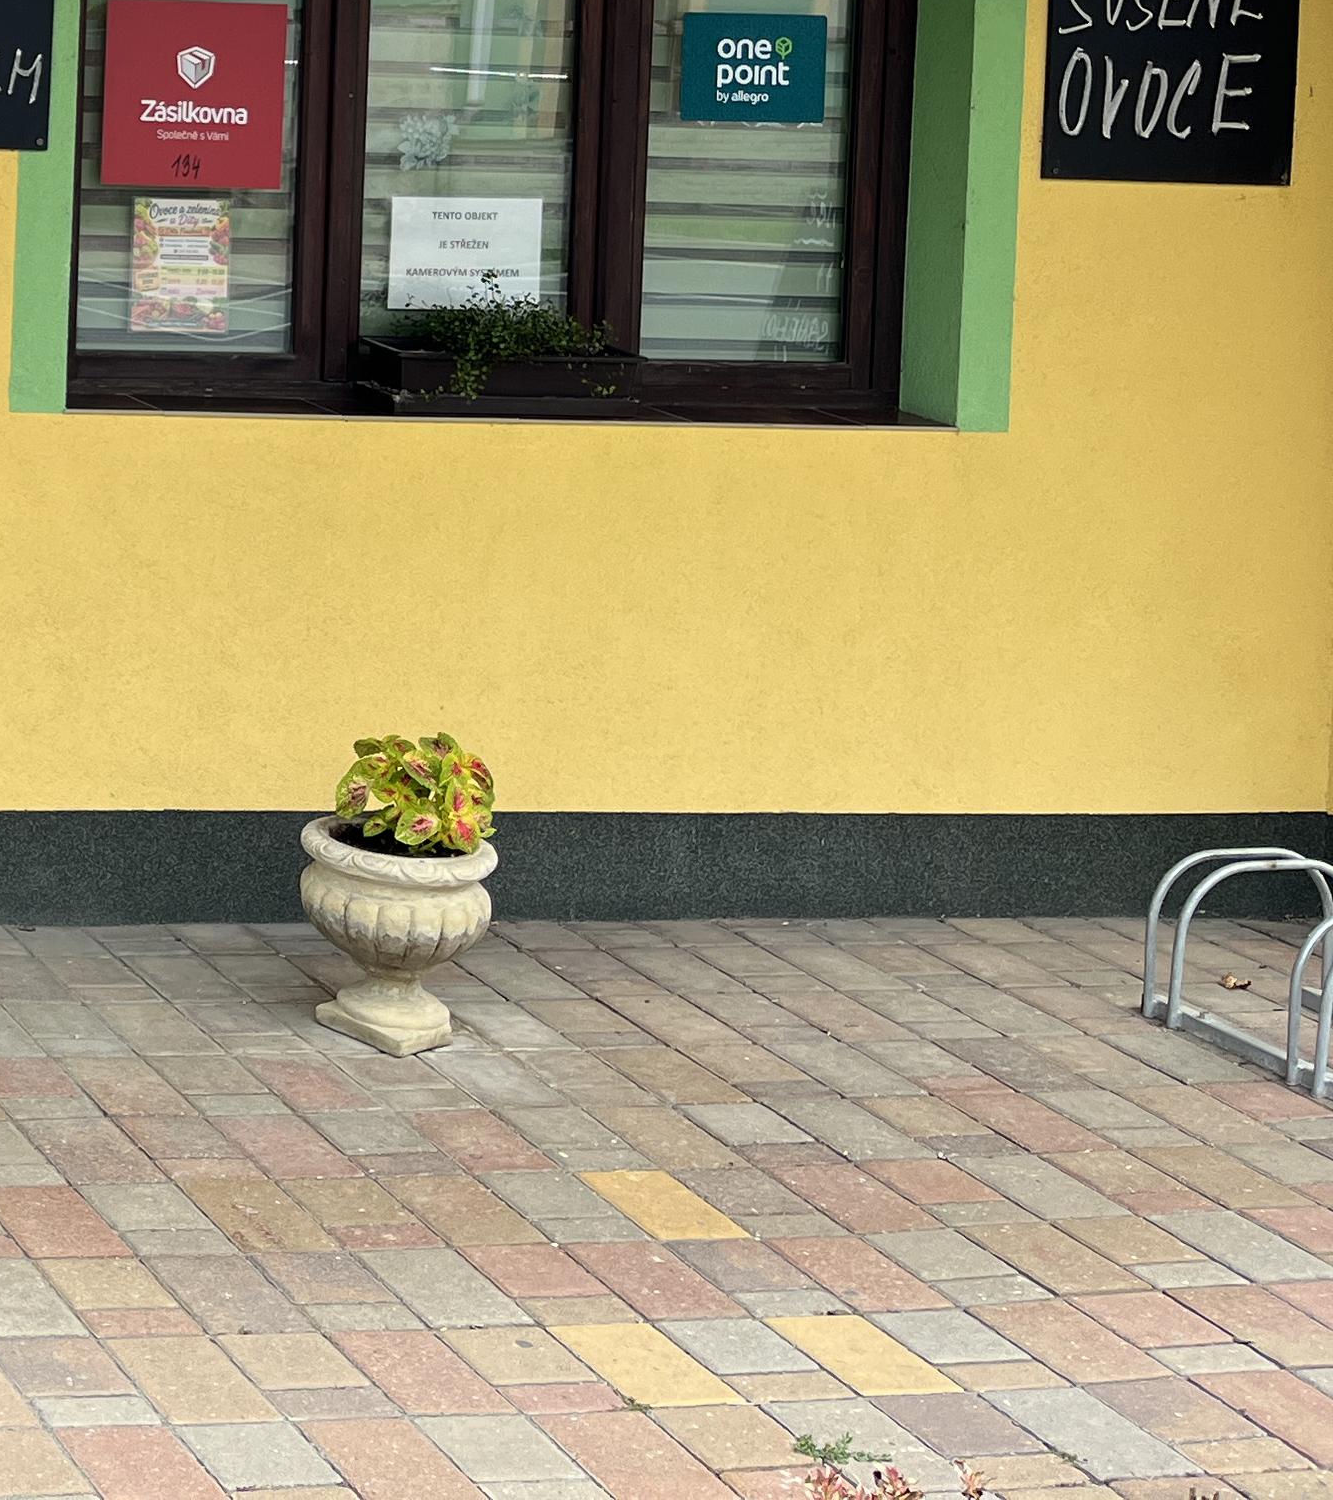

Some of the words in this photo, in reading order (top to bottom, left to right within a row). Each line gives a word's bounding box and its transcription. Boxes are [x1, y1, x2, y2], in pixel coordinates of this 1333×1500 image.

[717, 38, 772, 59] one
[717, 62, 790, 88] point
[716, 90, 729, 103] by
[731, 90, 769, 105] allegro
[1058, 47, 1262, 139] OVOCE
[140, 99, 248, 125] Zásilkovna
[156, 128, 198, 142] Společně
[206, 131, 229, 141] Vámi
[171, 154, 201, 180] 134
[432, 212, 462, 220] TENTO
[465, 212, 498, 221] OBJEKT
[439, 241, 447, 249] JE
[449, 239, 489, 249] STŘEŽEN
[406, 267, 467, 277] KAMEROVÝM
